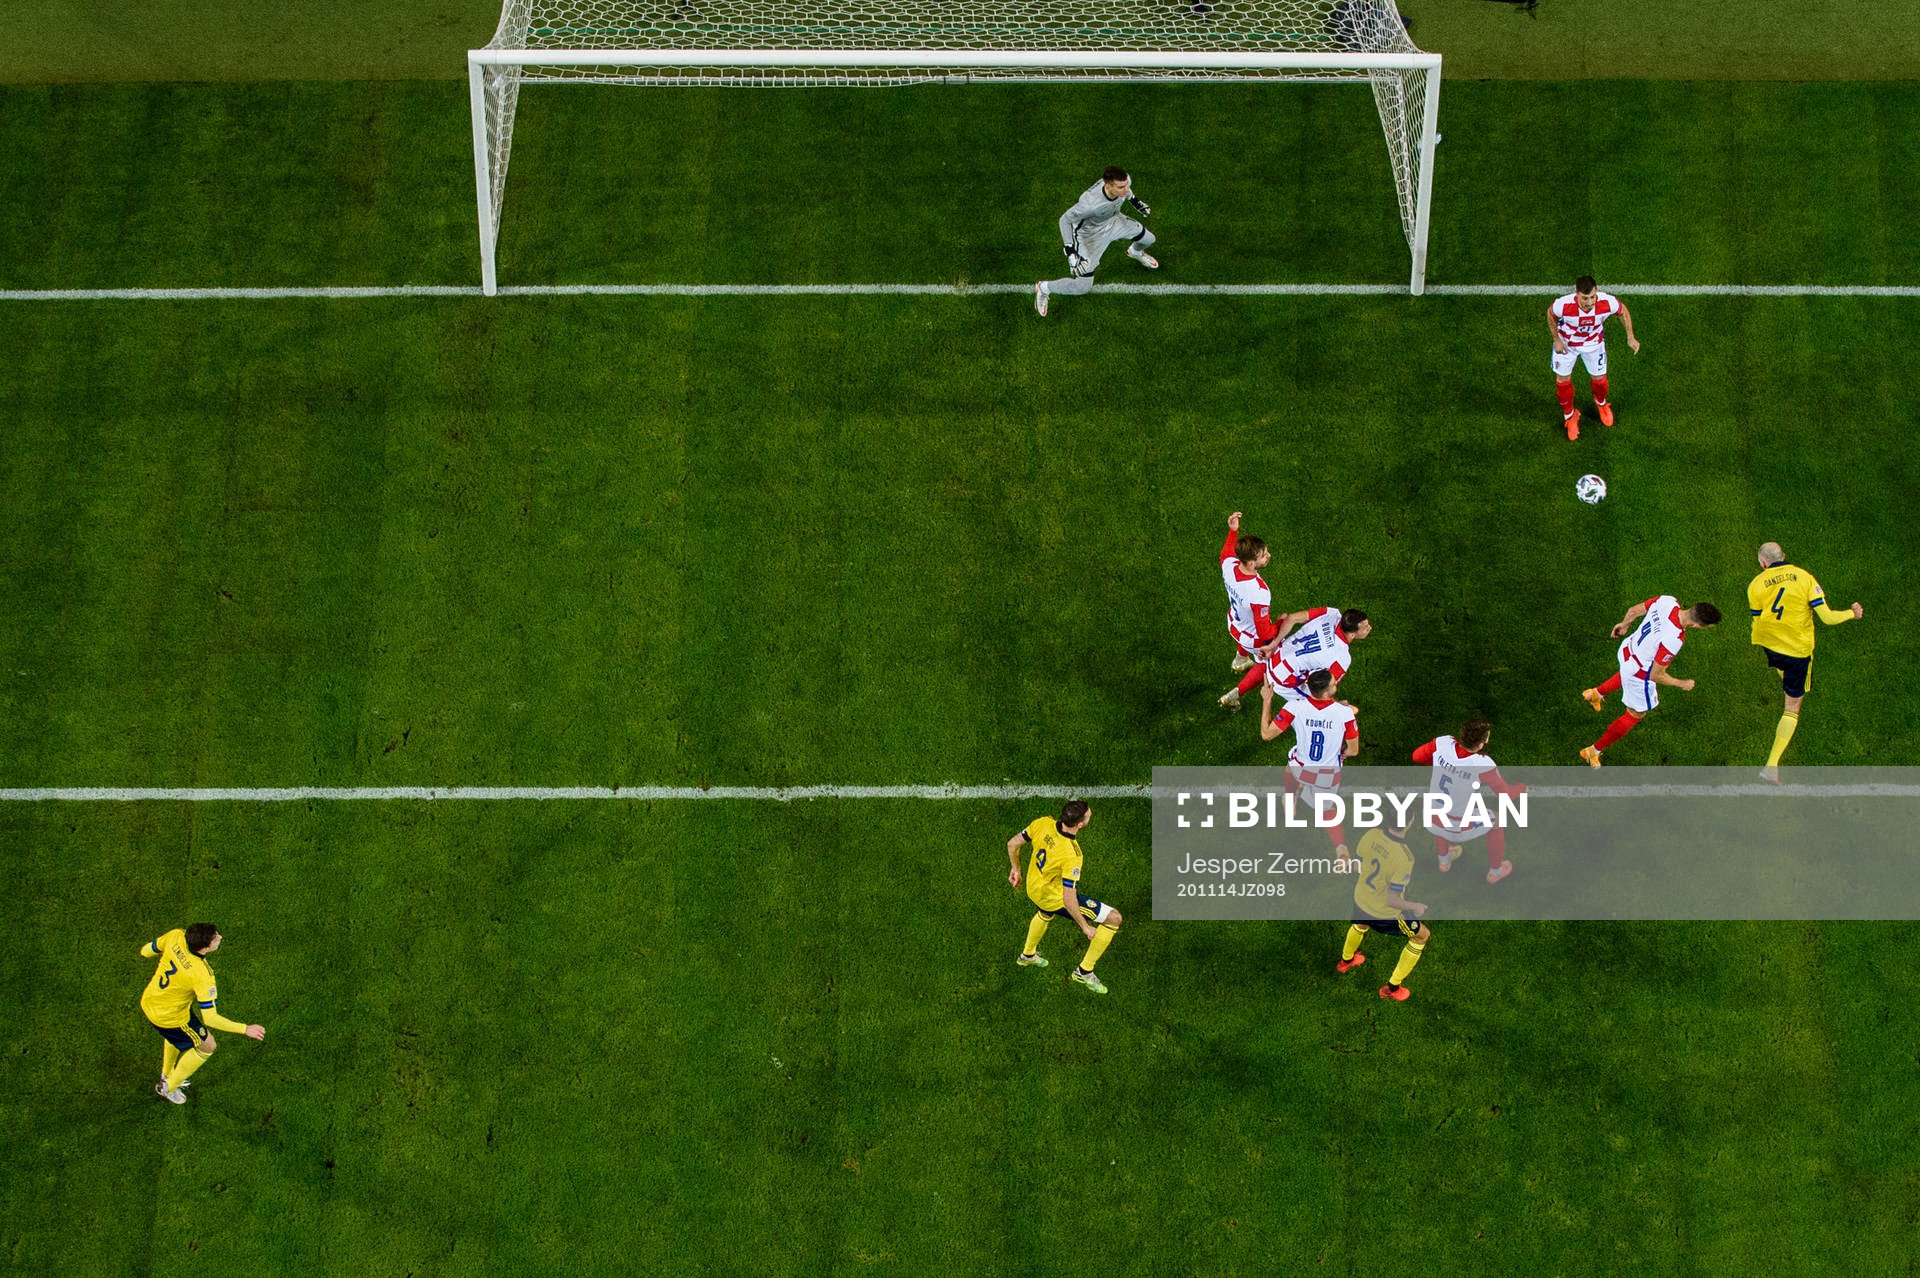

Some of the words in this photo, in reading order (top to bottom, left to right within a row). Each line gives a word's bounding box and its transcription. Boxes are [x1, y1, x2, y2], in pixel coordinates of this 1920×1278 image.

[1771, 587, 1785, 620] 4
[1292, 629, 1322, 657] 14
[1637, 621, 1652, 647] 4
[1309, 730, 1325, 762] 8
[1036, 848, 1047, 874] 9
[1365, 857, 1380, 890] 2
[159, 960, 178, 990] 3
